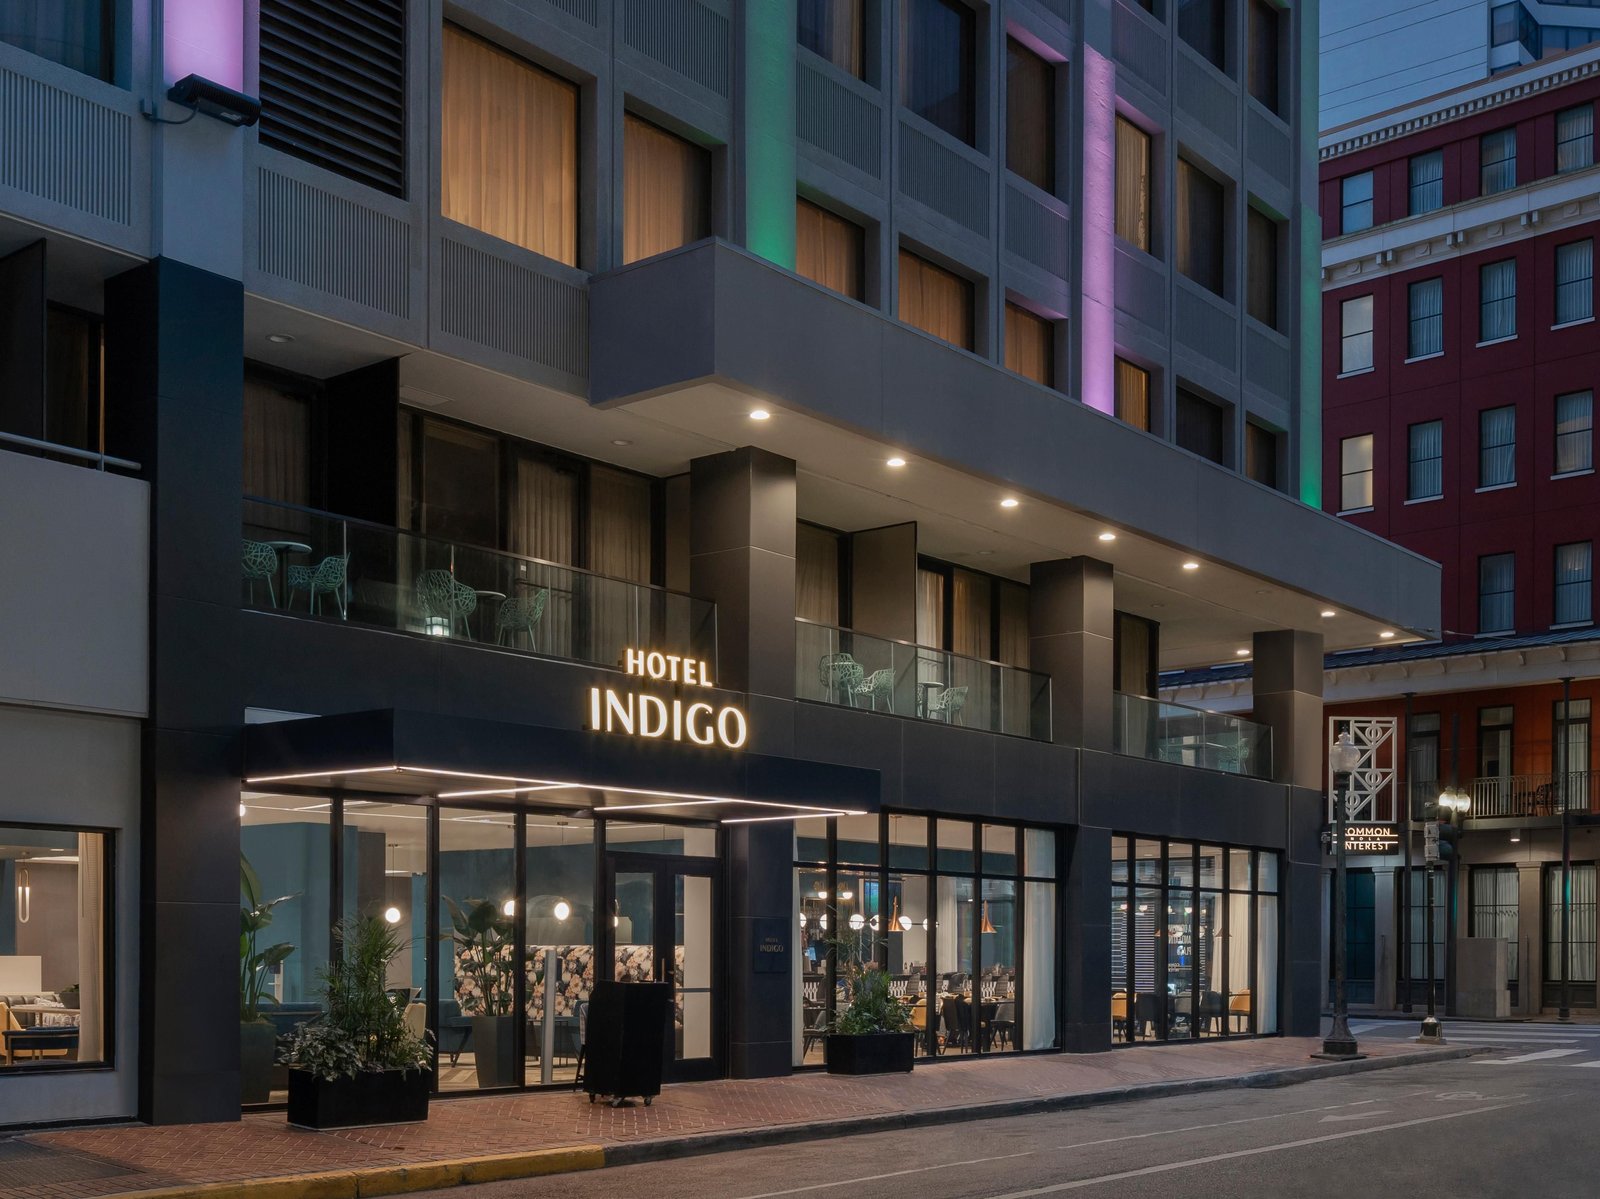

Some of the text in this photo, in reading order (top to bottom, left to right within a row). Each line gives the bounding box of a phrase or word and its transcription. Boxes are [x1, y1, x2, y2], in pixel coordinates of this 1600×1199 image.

[627, 648, 713, 687] HOTEL
[591, 687, 747, 748] INDIGO
[1345, 841, 1389, 850] NTEREST
[759, 944, 784, 953] INDIGO
